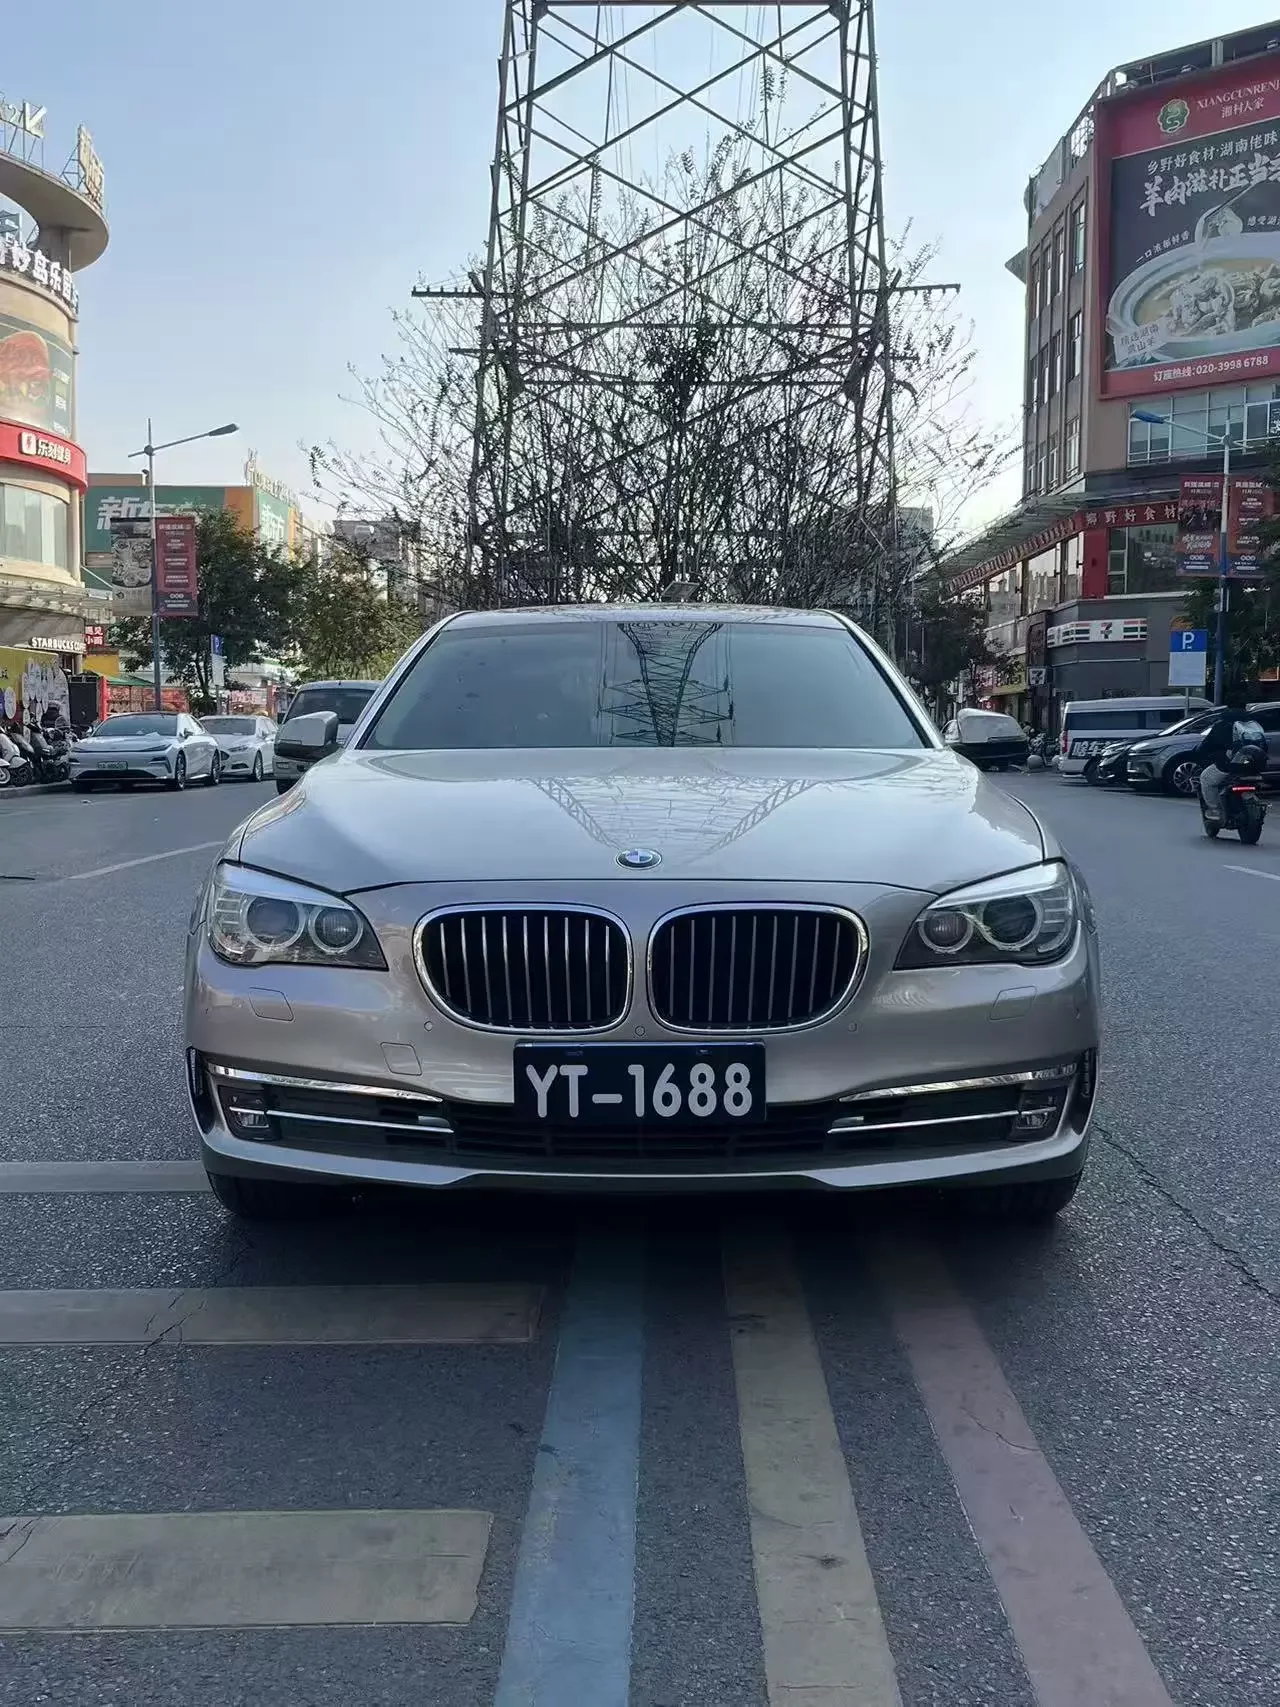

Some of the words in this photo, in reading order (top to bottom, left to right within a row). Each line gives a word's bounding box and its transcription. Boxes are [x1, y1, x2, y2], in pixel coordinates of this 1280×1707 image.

[1243, 355, 1269, 367] 6788
[31, 637, 73, 650] STARBUCKS
[526, 1063, 752, 1118] YT-1688
